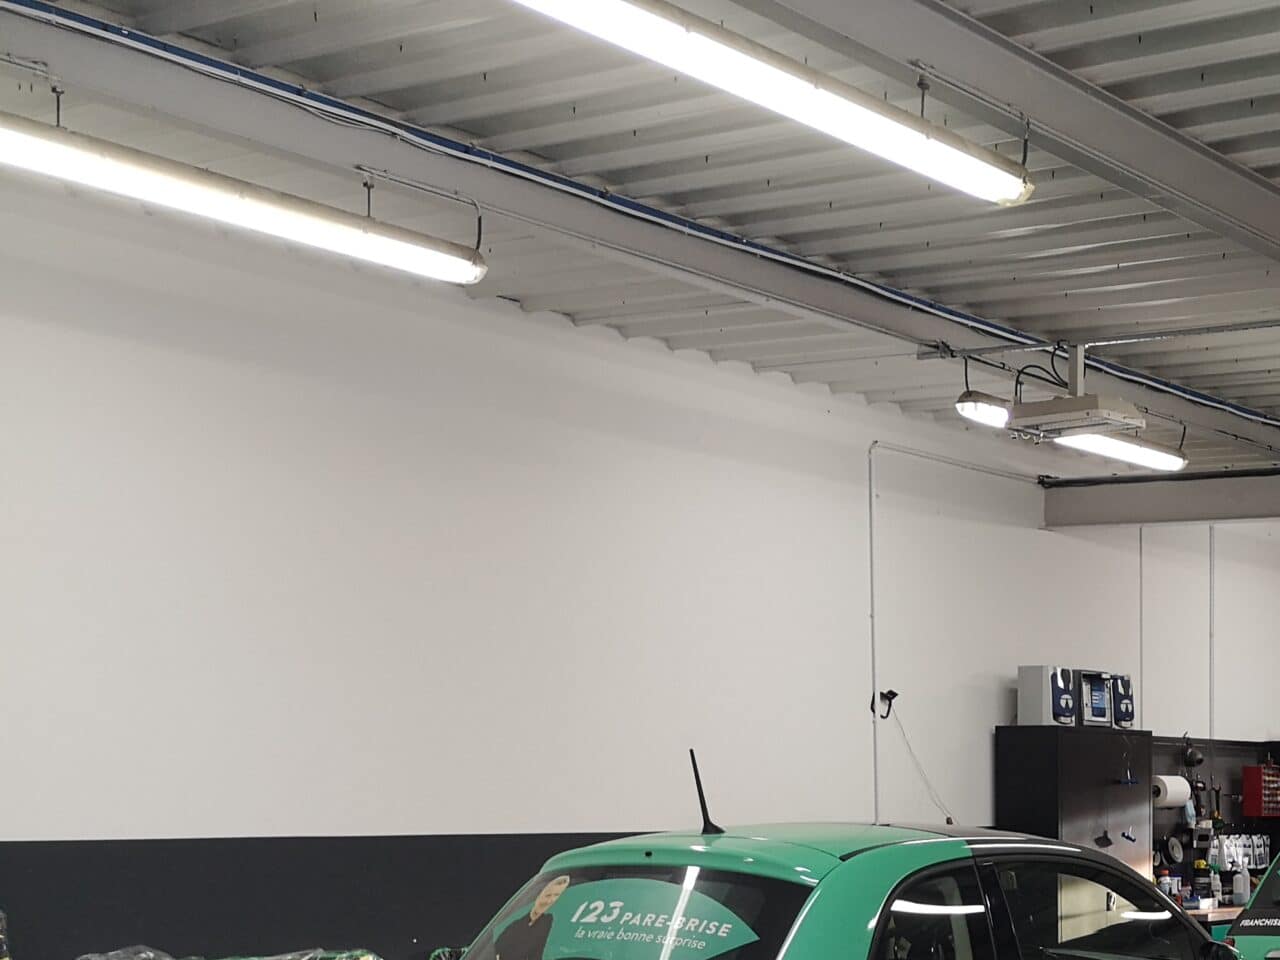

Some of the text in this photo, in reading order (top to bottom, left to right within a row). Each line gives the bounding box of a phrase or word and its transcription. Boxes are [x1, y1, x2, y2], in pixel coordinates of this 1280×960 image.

[570, 900, 733, 938] 123 PARE-BRISE
[574, 926, 586, 939] la
[588, 926, 615, 940] vraie
[617, 927, 654, 943] bonne
